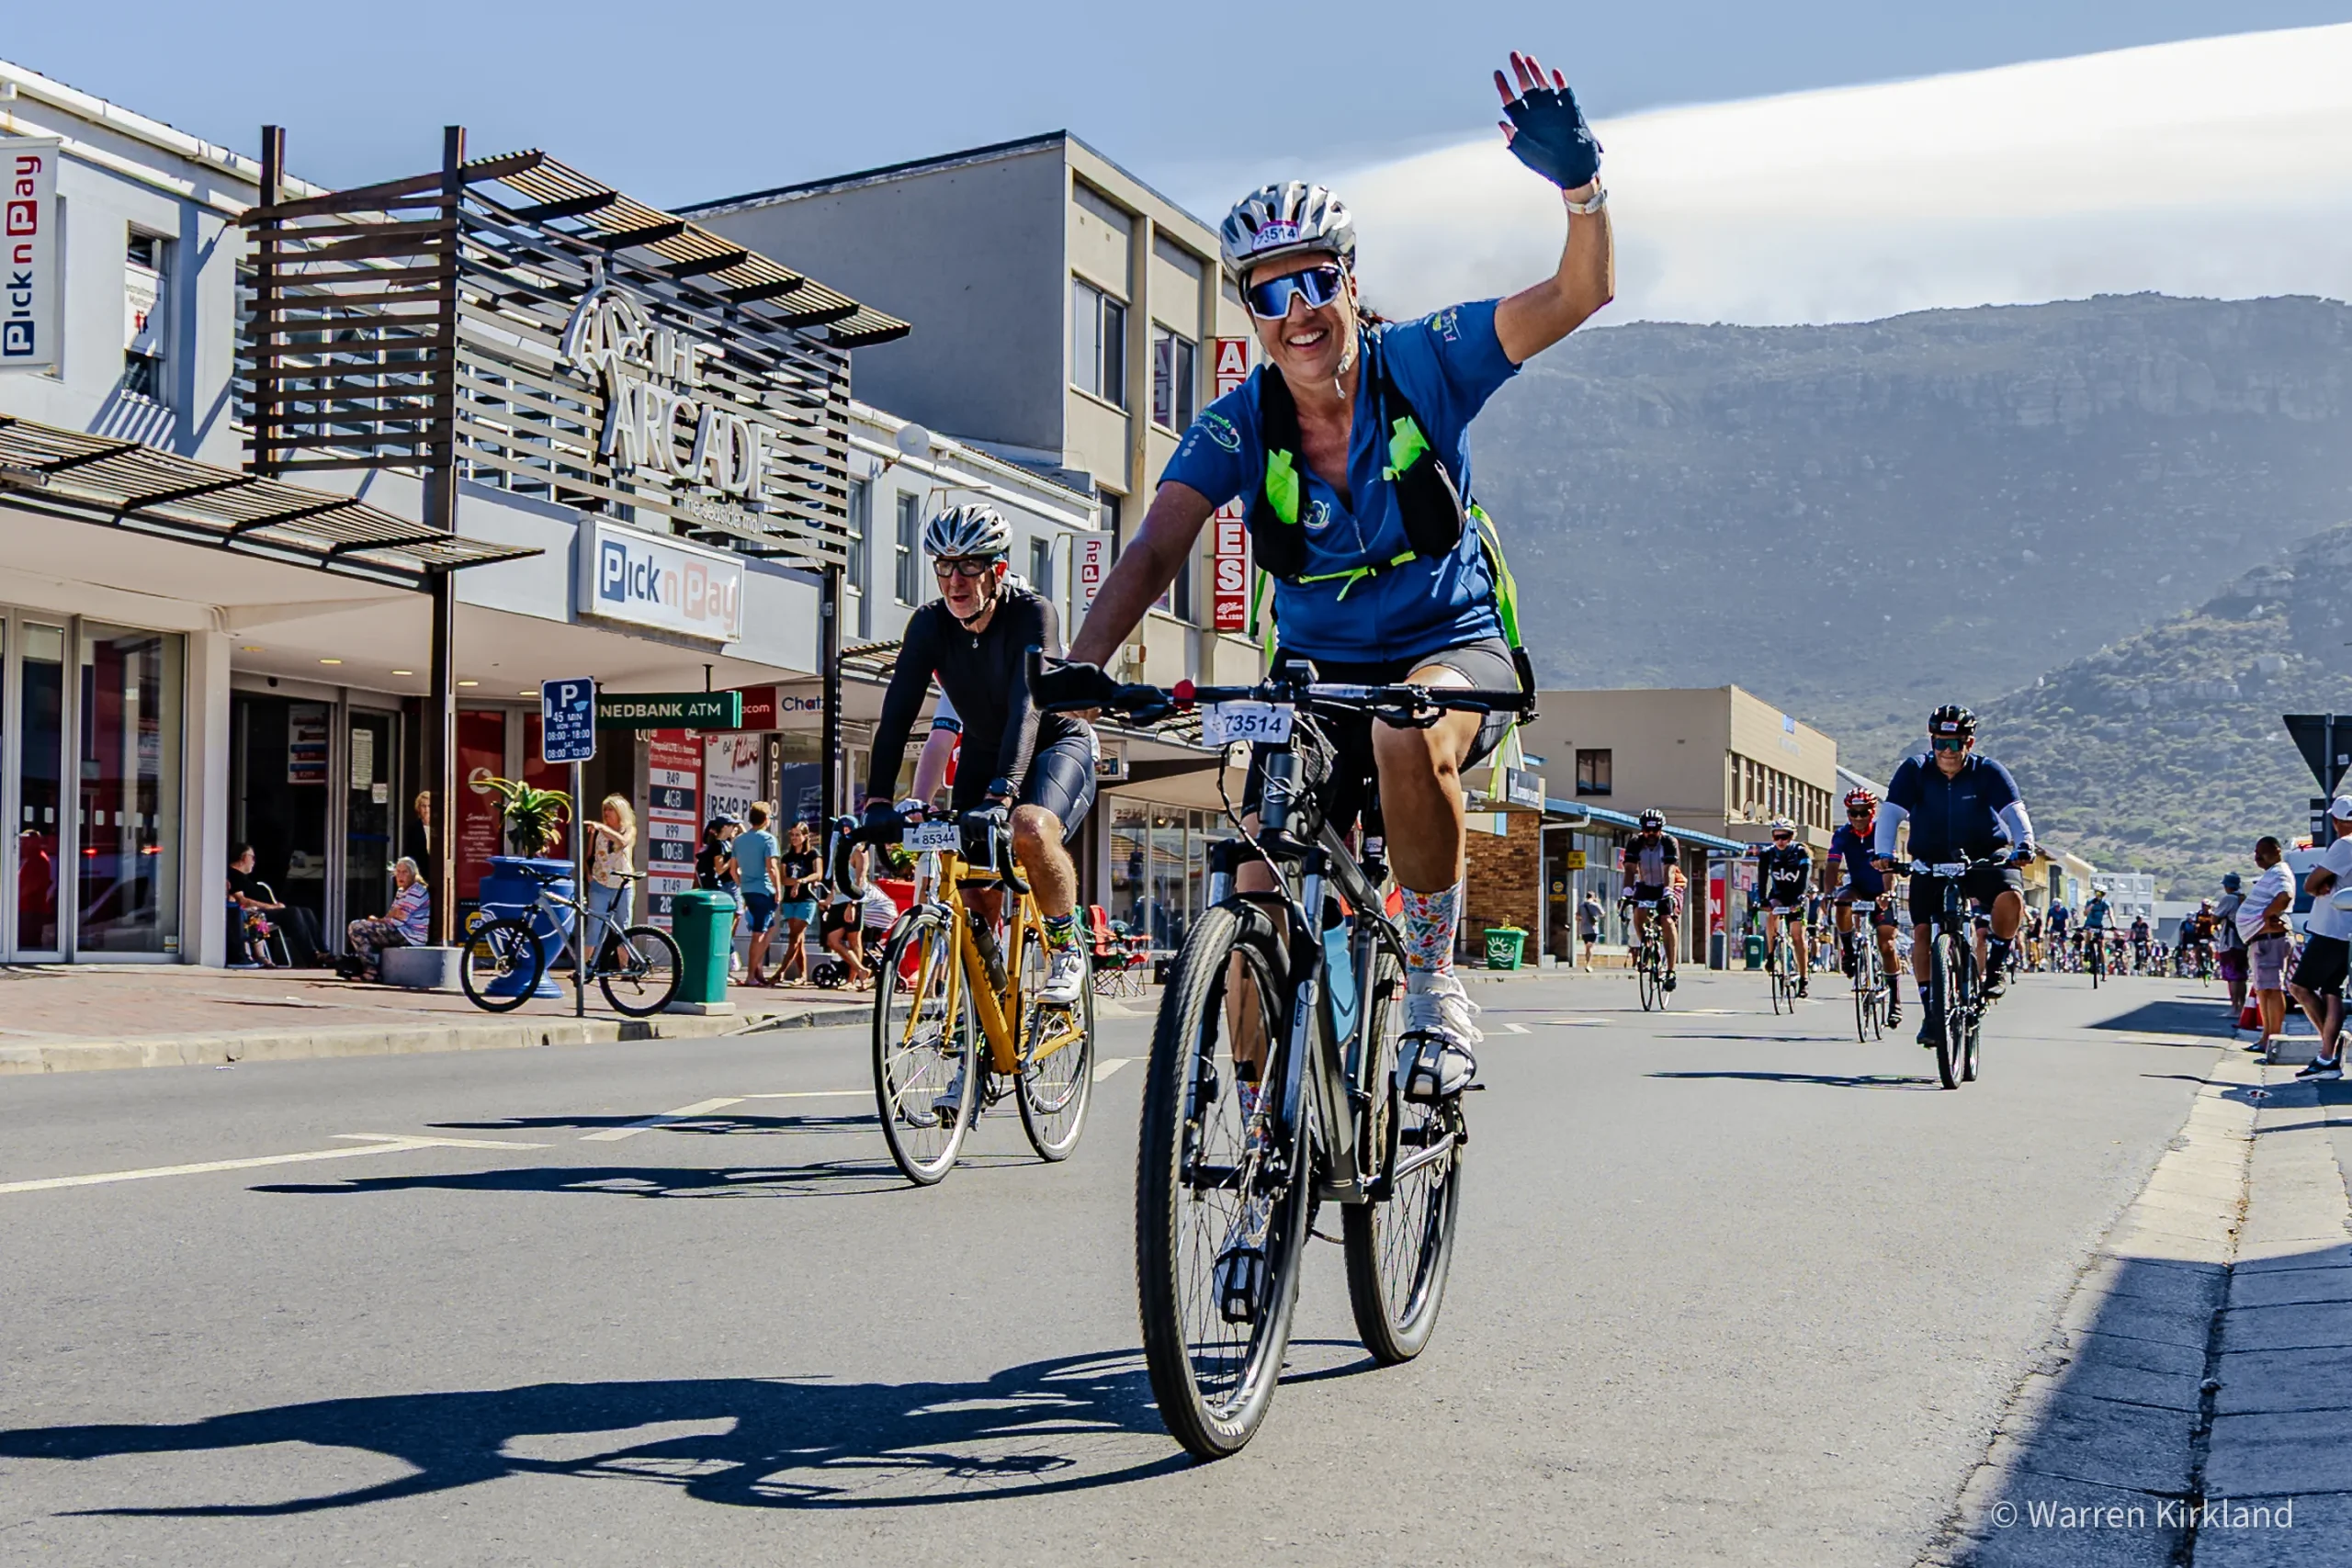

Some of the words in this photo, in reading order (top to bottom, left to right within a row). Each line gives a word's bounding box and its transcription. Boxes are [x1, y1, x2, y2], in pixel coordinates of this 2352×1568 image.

[6, 156, 41, 236] Pay
[14, 243, 32, 264] n
[4, 271, 34, 356] Pick
[651, 322, 707, 388] THE
[601, 374, 777, 502] ARCADE
[702, 498, 741, 528] seaside
[1082, 541, 1102, 583] Pay
[600, 540, 660, 604] Pick
[664, 570, 677, 607] n
[683, 561, 736, 631] Pay
[560, 684, 578, 707] P
[782, 695, 822, 711] Chat
[552, 712, 564, 722] 45
[600, 704, 682, 717] NEDBANK
[688, 704, 721, 716] ATM
[1225, 714, 1282, 733] 73514
[547, 731, 566, 741] 08:00
[547, 749, 566, 759] 08:00
[666, 772, 680, 785] R49
[664, 789, 681, 807] 4GB
[665, 825, 679, 838] R99
[922, 833, 956, 844] 85344
[662, 842, 684, 860] 10GB
[1772, 868, 1800, 883] sky
[662, 879, 680, 892] R149
